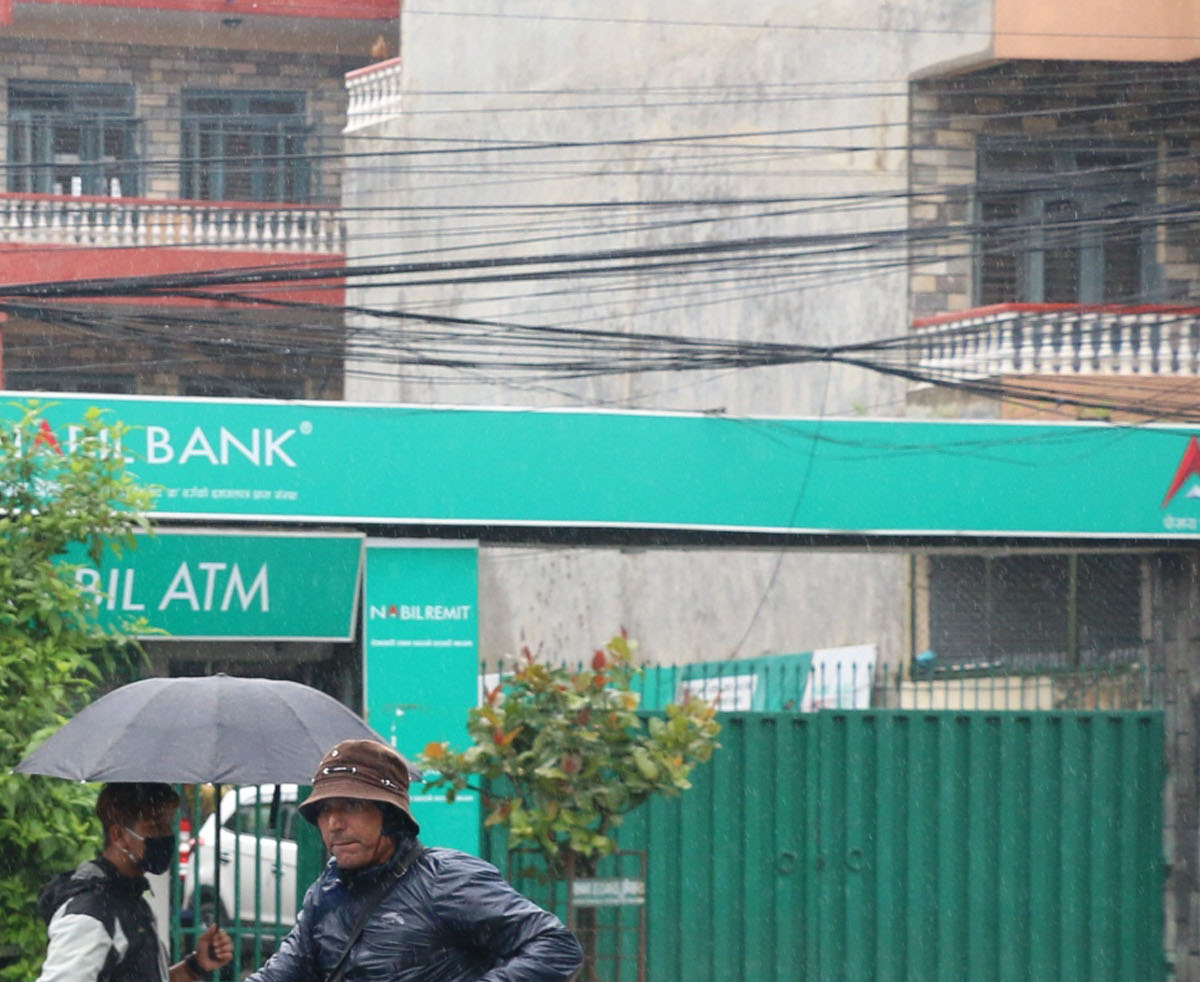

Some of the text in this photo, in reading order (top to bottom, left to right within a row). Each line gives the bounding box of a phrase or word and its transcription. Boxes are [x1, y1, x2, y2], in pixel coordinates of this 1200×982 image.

[74, 560, 270, 612] BIL ATM
[424, 604, 471, 620] REMIT
